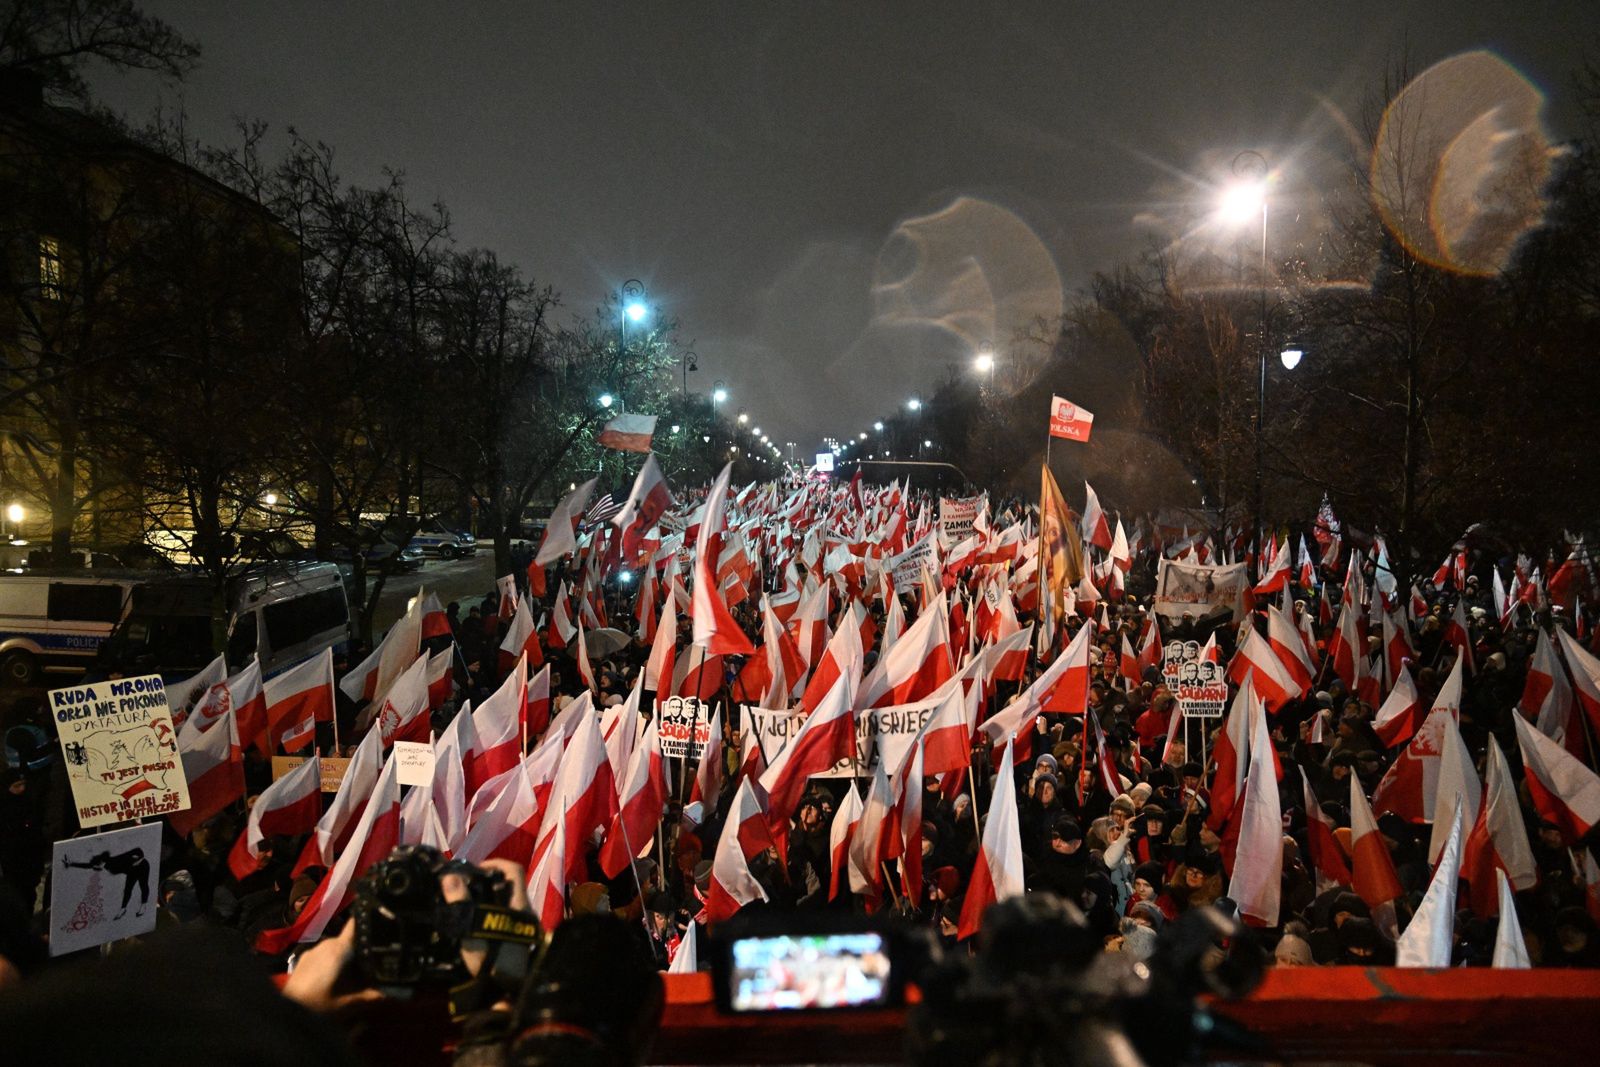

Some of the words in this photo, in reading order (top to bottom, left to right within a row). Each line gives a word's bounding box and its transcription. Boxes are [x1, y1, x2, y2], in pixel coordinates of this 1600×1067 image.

[66, 637, 101, 649] POLICJ
[53, 687, 97, 707] RUDA
[110, 678, 163, 696] WRONA
[57, 704, 91, 723] ORŁA
[119, 691, 167, 713] POKONA
[73, 709, 152, 732] DYKTATURA
[101, 771, 115, 782] TU
[118, 766, 140, 780] JEST
[142, 761, 175, 773] POLSKA
[483, 912, 536, 937] Nikon
